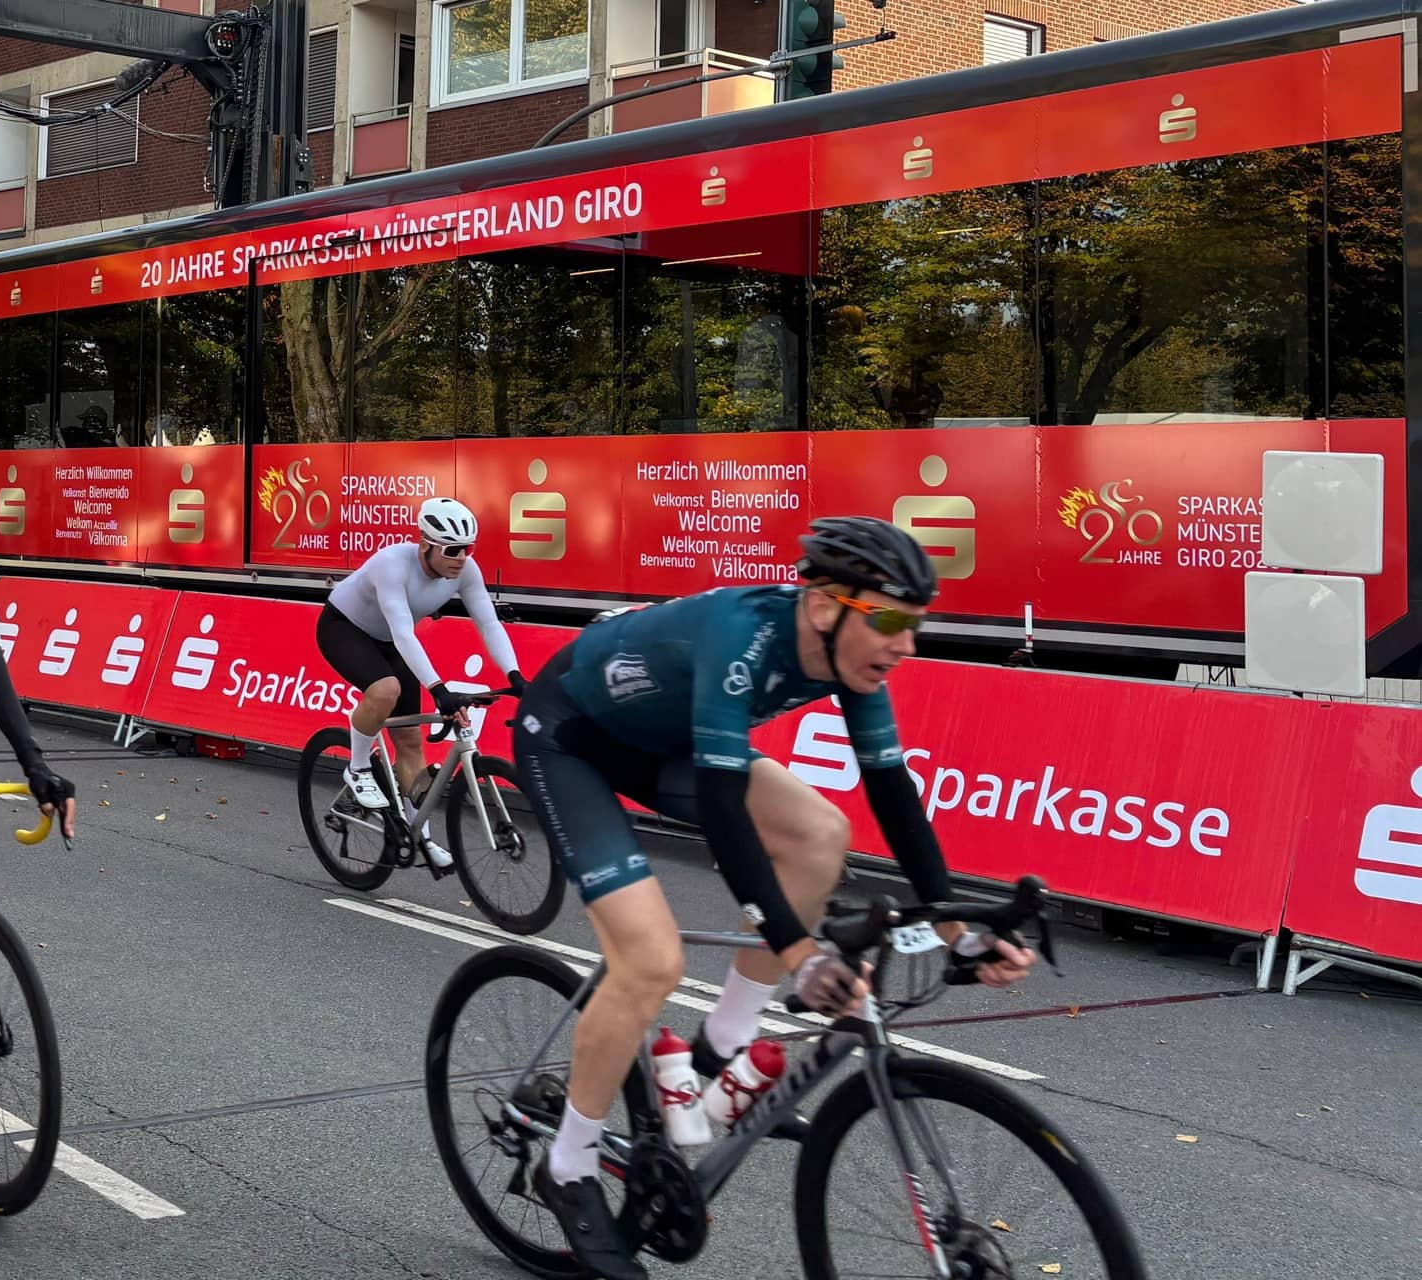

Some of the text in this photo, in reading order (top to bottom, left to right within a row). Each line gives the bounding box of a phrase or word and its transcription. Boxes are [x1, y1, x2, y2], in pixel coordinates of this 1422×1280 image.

[141, 182, 643, 288] 20 JAHRE SPARKASSEN MÜNSTERLAND GIRO
[55, 465, 133, 481] Herzlich Willkommen
[636, 460, 806, 481] Herzlich Willkommen
[89, 485, 129, 500] Bienvenido
[341, 475, 436, 497] SPARKASSEN
[73, 499, 113, 515] Welcome
[652, 489, 800, 510] Velkomst Bienvenido
[1178, 496, 1263, 516] SPARKA
[66, 516, 93, 530] Welkom
[340, 499, 418, 526] MÜNSTERL
[678, 509, 762, 533] Welcome
[88, 530, 129, 547] Välkomna
[1178, 518, 1262, 543] MÜNSTE
[297, 534, 330, 550] JAHRE
[339, 531, 374, 552] GIRO
[662, 535, 777, 557] Welkom Accueillir
[640, 553, 798, 582] Benvenuto Välkomna
[1116, 550, 1162, 566] JAHRE
[1177, 547, 1273, 569] GIRO 202
[222, 657, 363, 716] Sparkass
[901, 748, 1230, 857] Sparkasse
